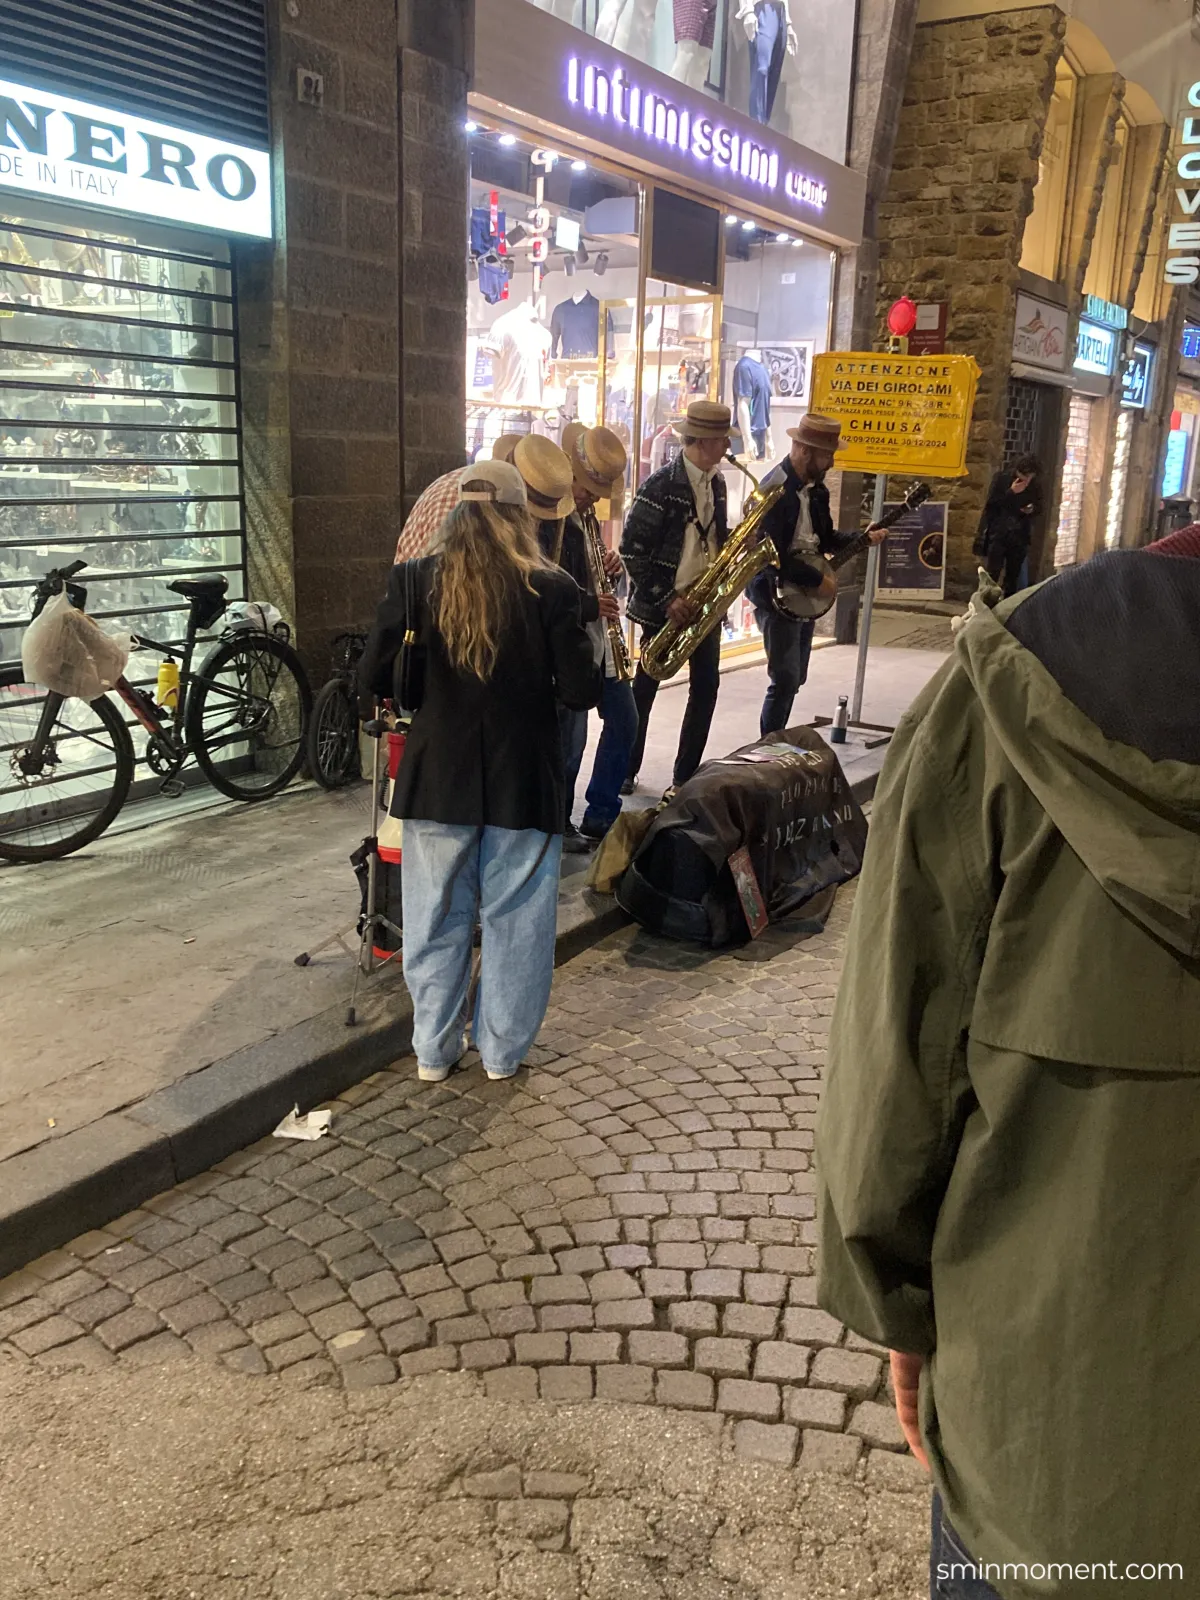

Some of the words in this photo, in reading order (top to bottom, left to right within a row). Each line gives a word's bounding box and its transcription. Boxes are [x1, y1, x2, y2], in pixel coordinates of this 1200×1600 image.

[38, 161, 57, 184] IN
[70, 169, 118, 196] ITALY
[835, 363, 950, 376] ATTENZIONE
[830, 380, 852, 391] VIA
[857, 381, 879, 392] DEI
[883, 382, 952, 395] GIROLAMI
[849, 419, 922, 433] CHIUSA
